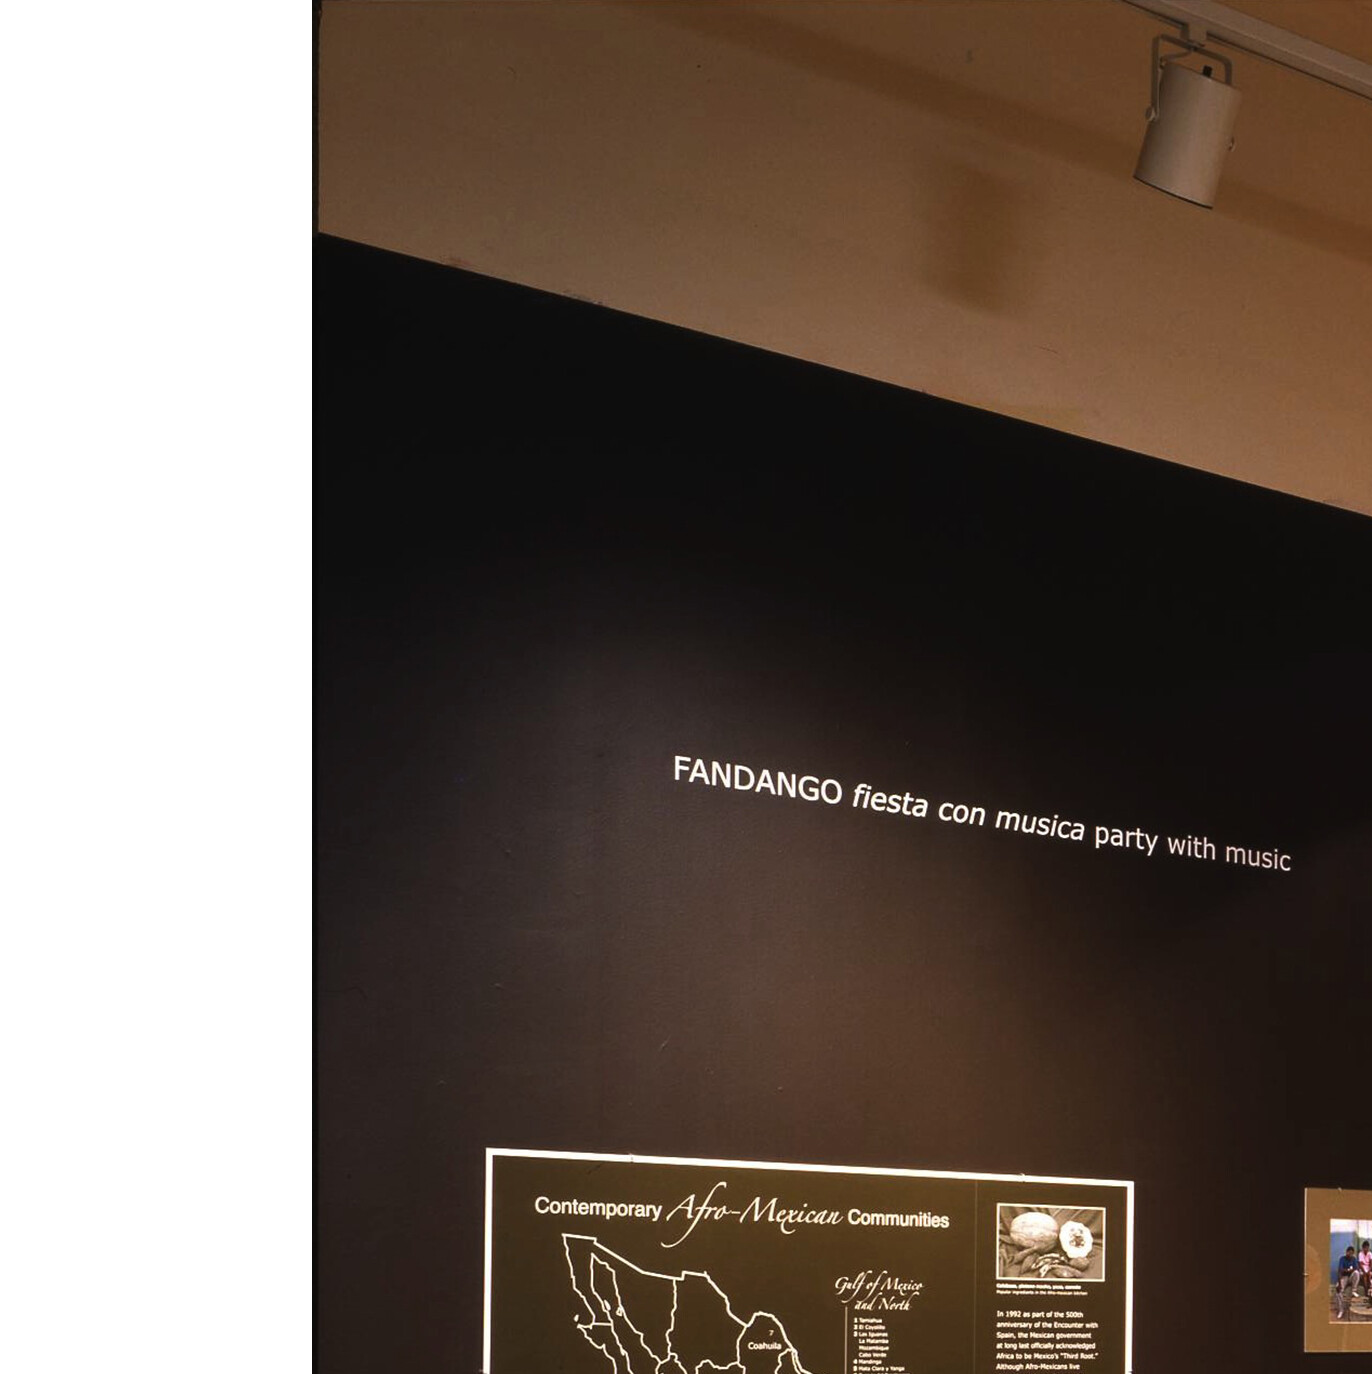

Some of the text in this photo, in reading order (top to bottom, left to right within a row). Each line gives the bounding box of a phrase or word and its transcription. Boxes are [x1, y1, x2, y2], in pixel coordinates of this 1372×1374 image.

[673, 754, 1291, 872] FANDANGO fiesta con musica party with music
[534, 1181, 950, 1248] Contemporary Afro-Mexican Communities
[835, 1270, 924, 1303] Gulf of Mexico
[854, 1291, 920, 1311] and North
[1032, 1311, 1045, 1319] part
[1056, 1332, 1091, 1340] government
[748, 1342, 782, 1350] Coahuila
[1004, 1342, 1017, 1350] long
